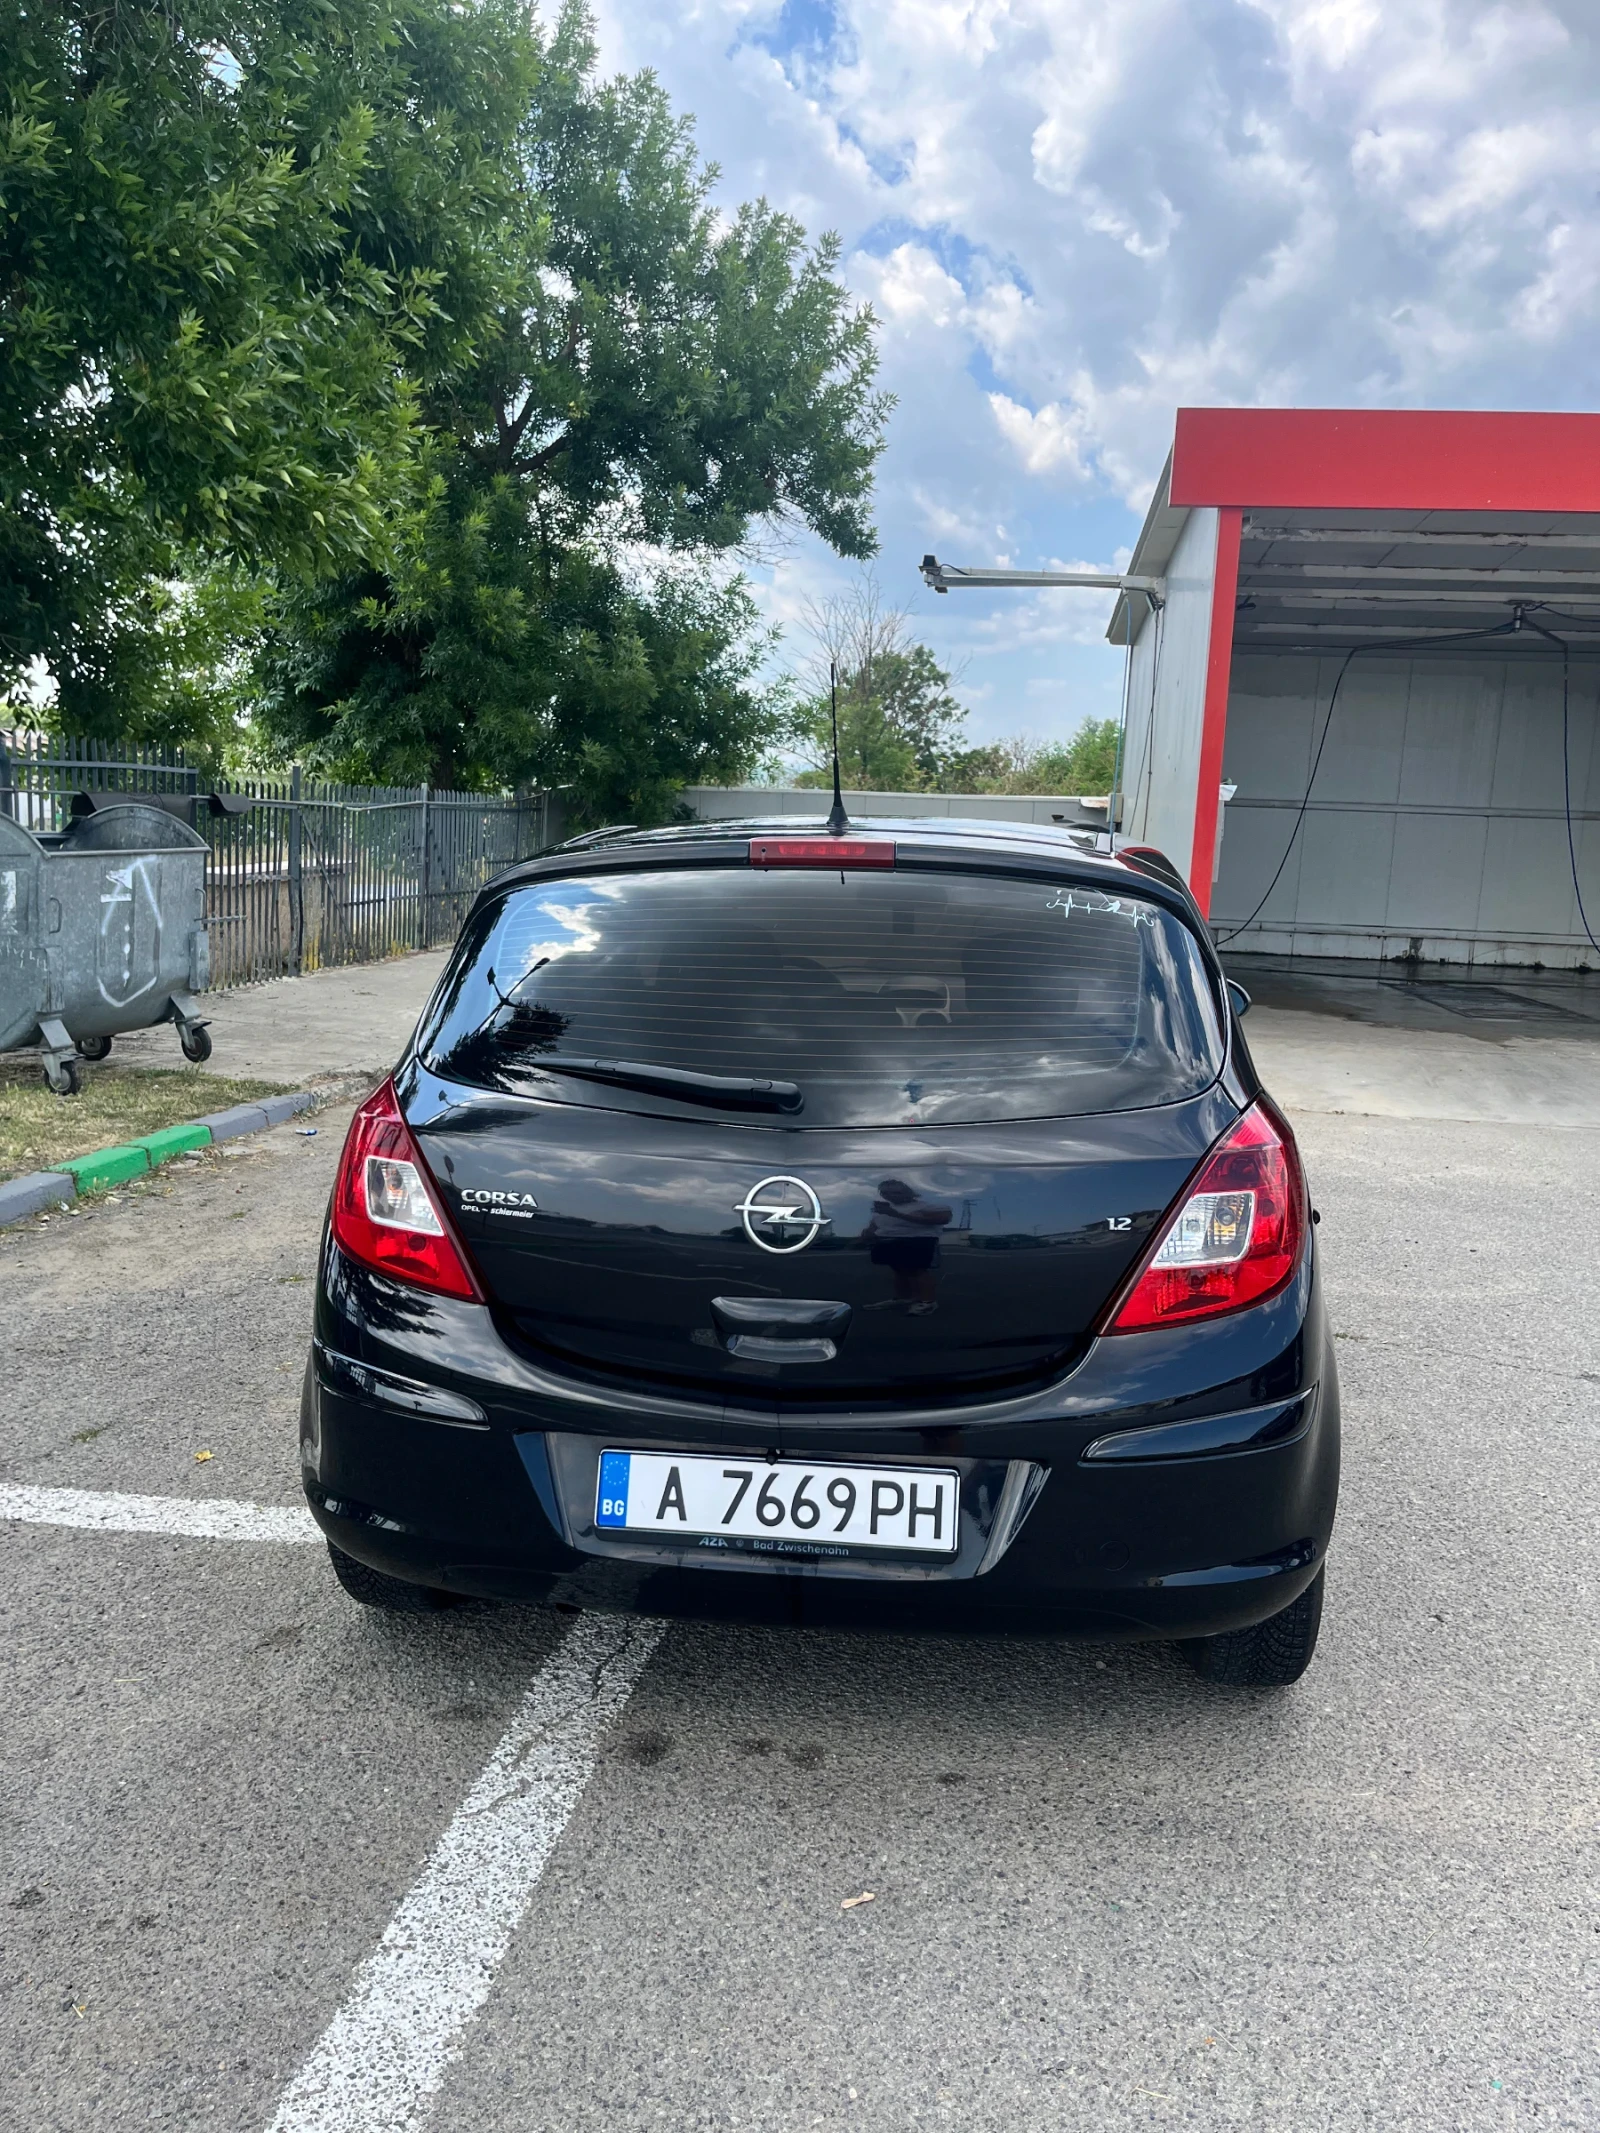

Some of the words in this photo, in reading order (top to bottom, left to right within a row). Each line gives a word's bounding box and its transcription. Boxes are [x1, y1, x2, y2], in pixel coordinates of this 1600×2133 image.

[461, 1189, 538, 1207] CORSA
[461, 1204, 480, 1212] OPEL
[1106, 1217, 1132, 1231] 1.2
[602, 1499, 625, 1516] BG
[656, 1466, 687, 1521] A
[721, 1470, 857, 1532] 7669
[870, 1480, 944, 1540] PH
[699, 1537, 728, 1547] AZA
[753, 1540, 774, 1550] Bad
[777, 1541, 849, 1556] Zwischenahn
